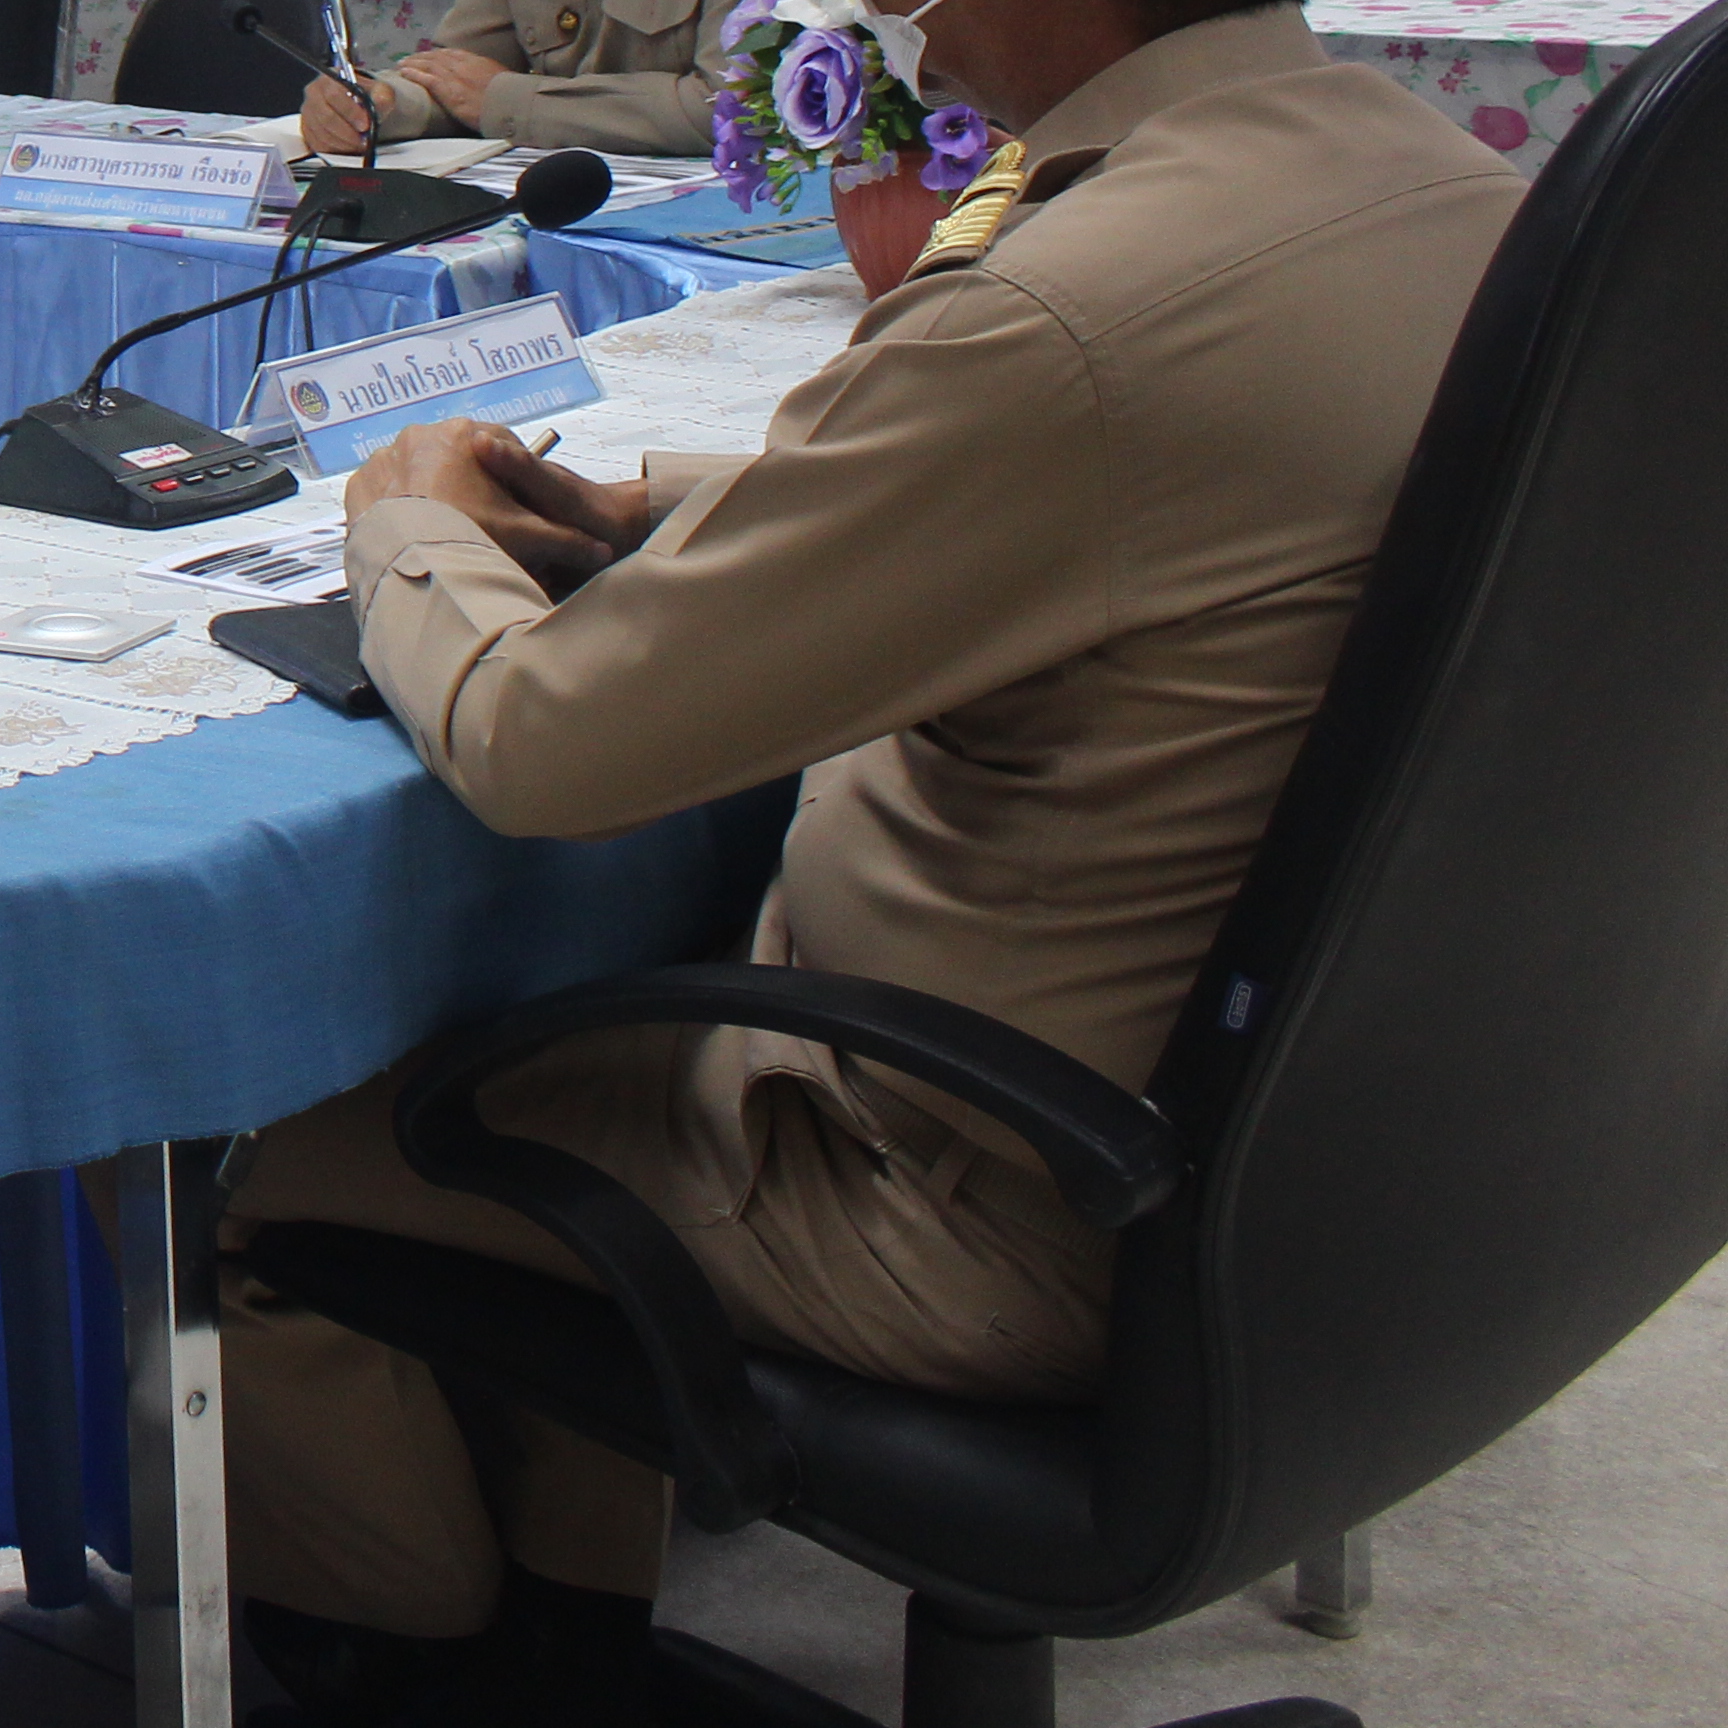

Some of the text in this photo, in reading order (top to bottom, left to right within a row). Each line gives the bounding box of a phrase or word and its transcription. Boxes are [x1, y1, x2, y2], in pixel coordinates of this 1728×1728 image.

[338, 332, 566, 413] นายไพโรจน์ โสภาพร
